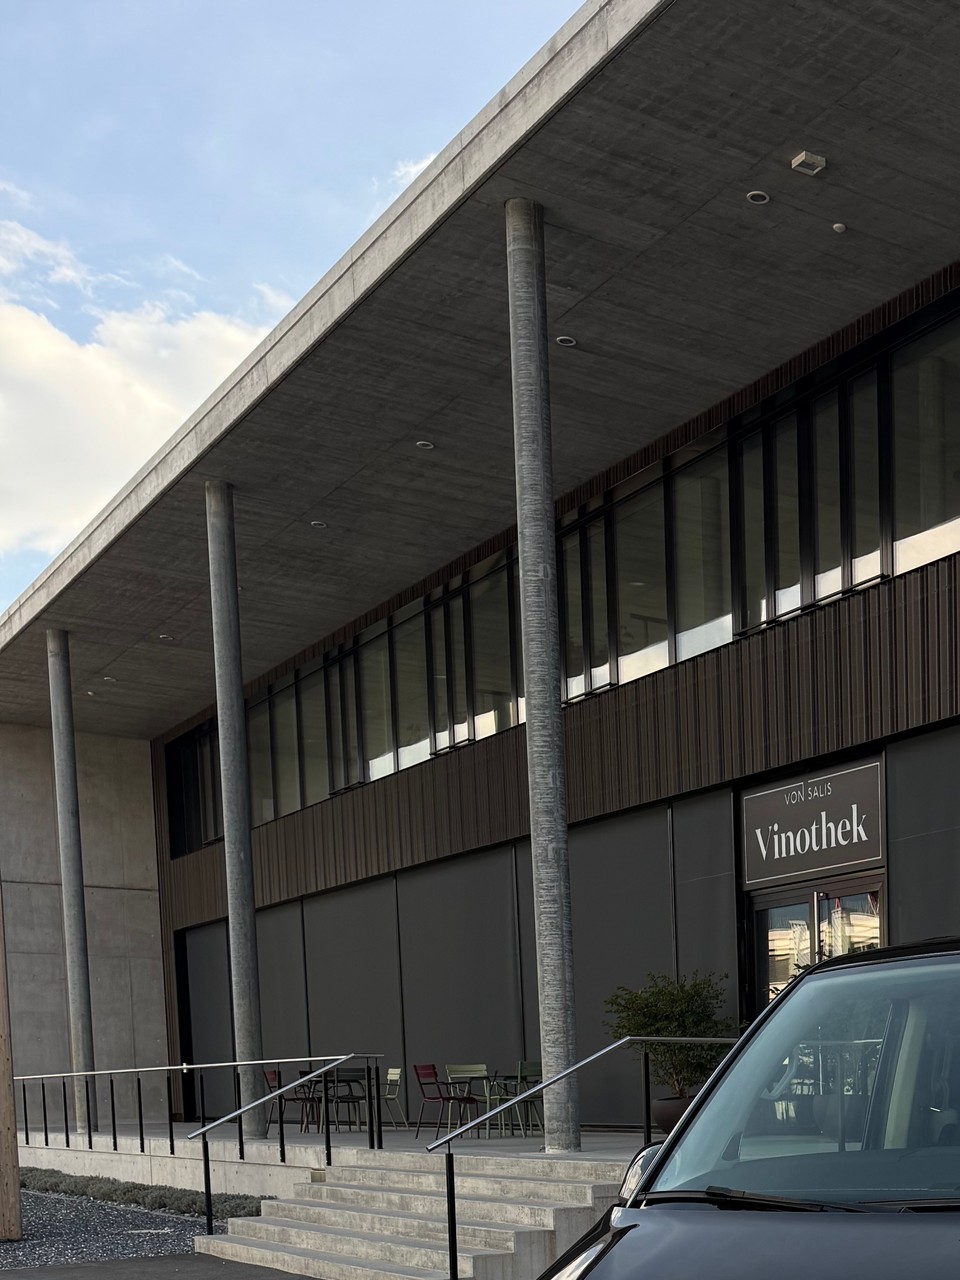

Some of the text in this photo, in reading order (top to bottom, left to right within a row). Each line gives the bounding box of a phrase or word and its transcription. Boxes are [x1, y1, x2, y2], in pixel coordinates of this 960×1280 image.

[784, 782, 832, 805] VON SALIS
[755, 803, 868, 861] Vinothek
